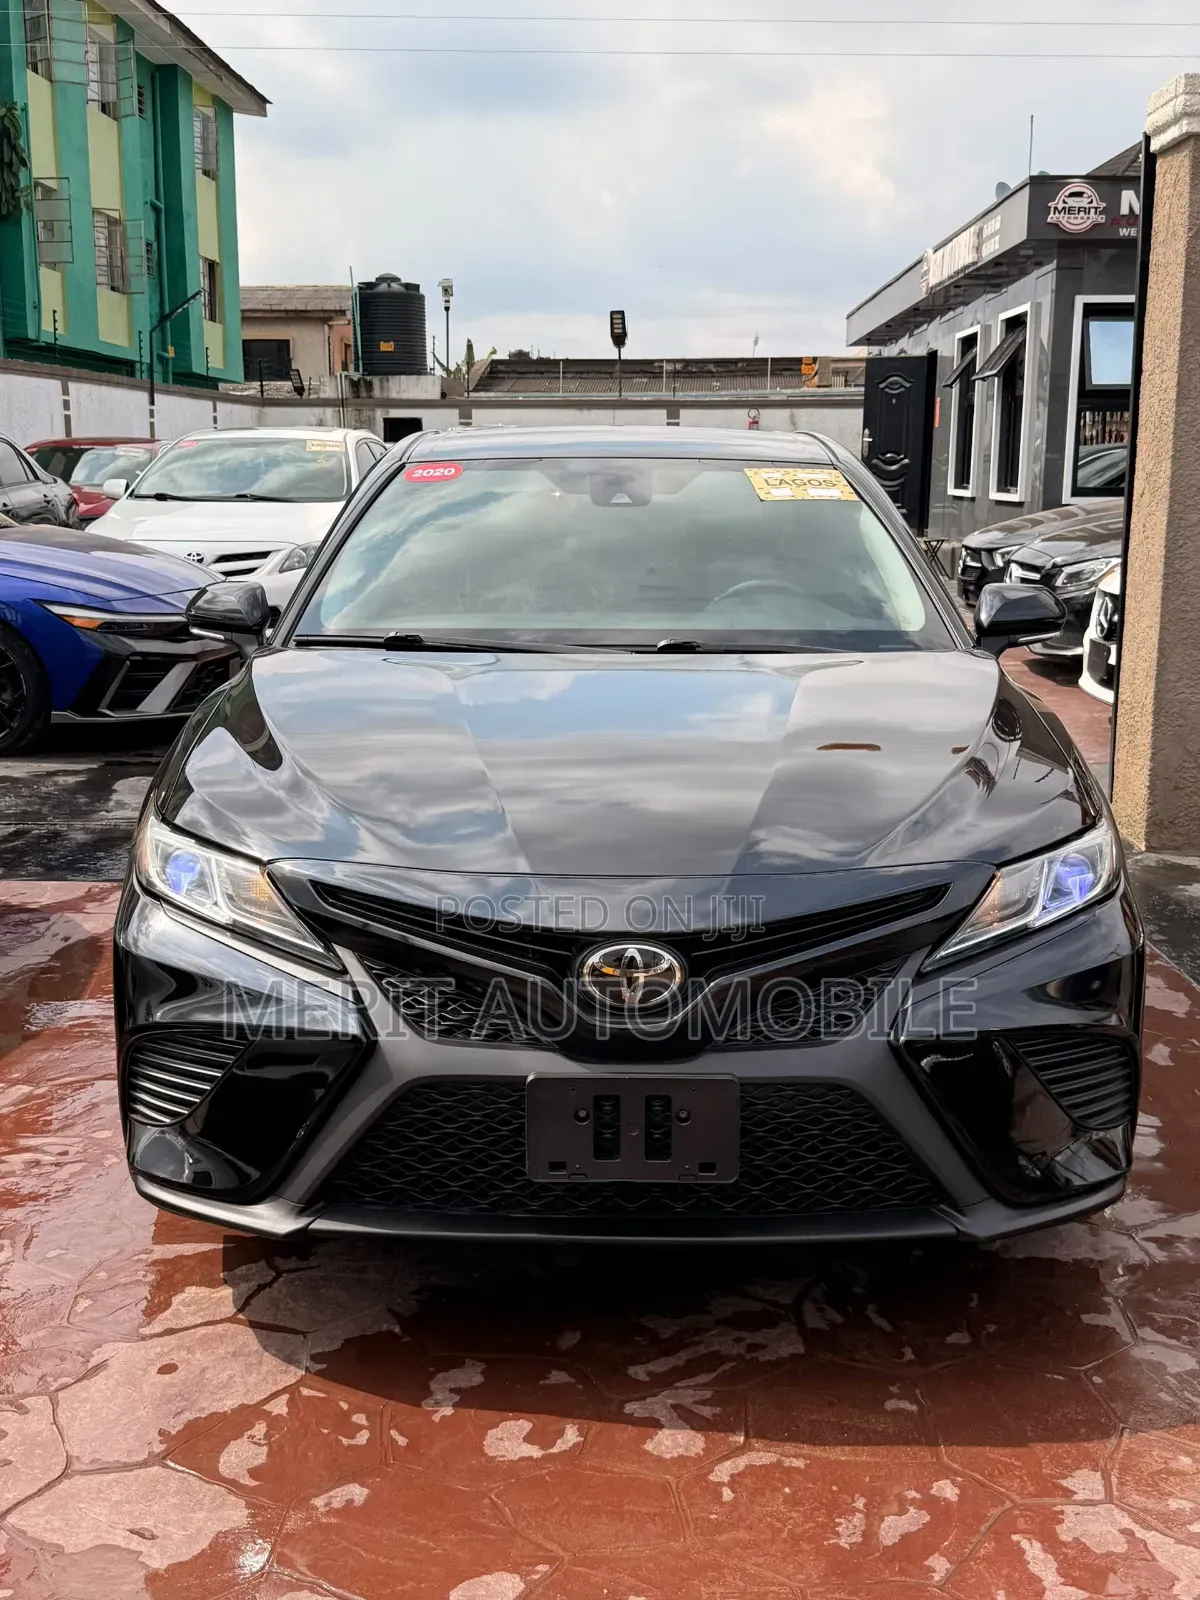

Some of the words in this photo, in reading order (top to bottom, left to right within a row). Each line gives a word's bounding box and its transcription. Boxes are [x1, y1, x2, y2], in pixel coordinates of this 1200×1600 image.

[1053, 205, 1102, 216] MERIT
[1118, 227, 1138, 237] WE
[411, 467, 456, 478] 2020
[764, 478, 838, 488] LAGOS
